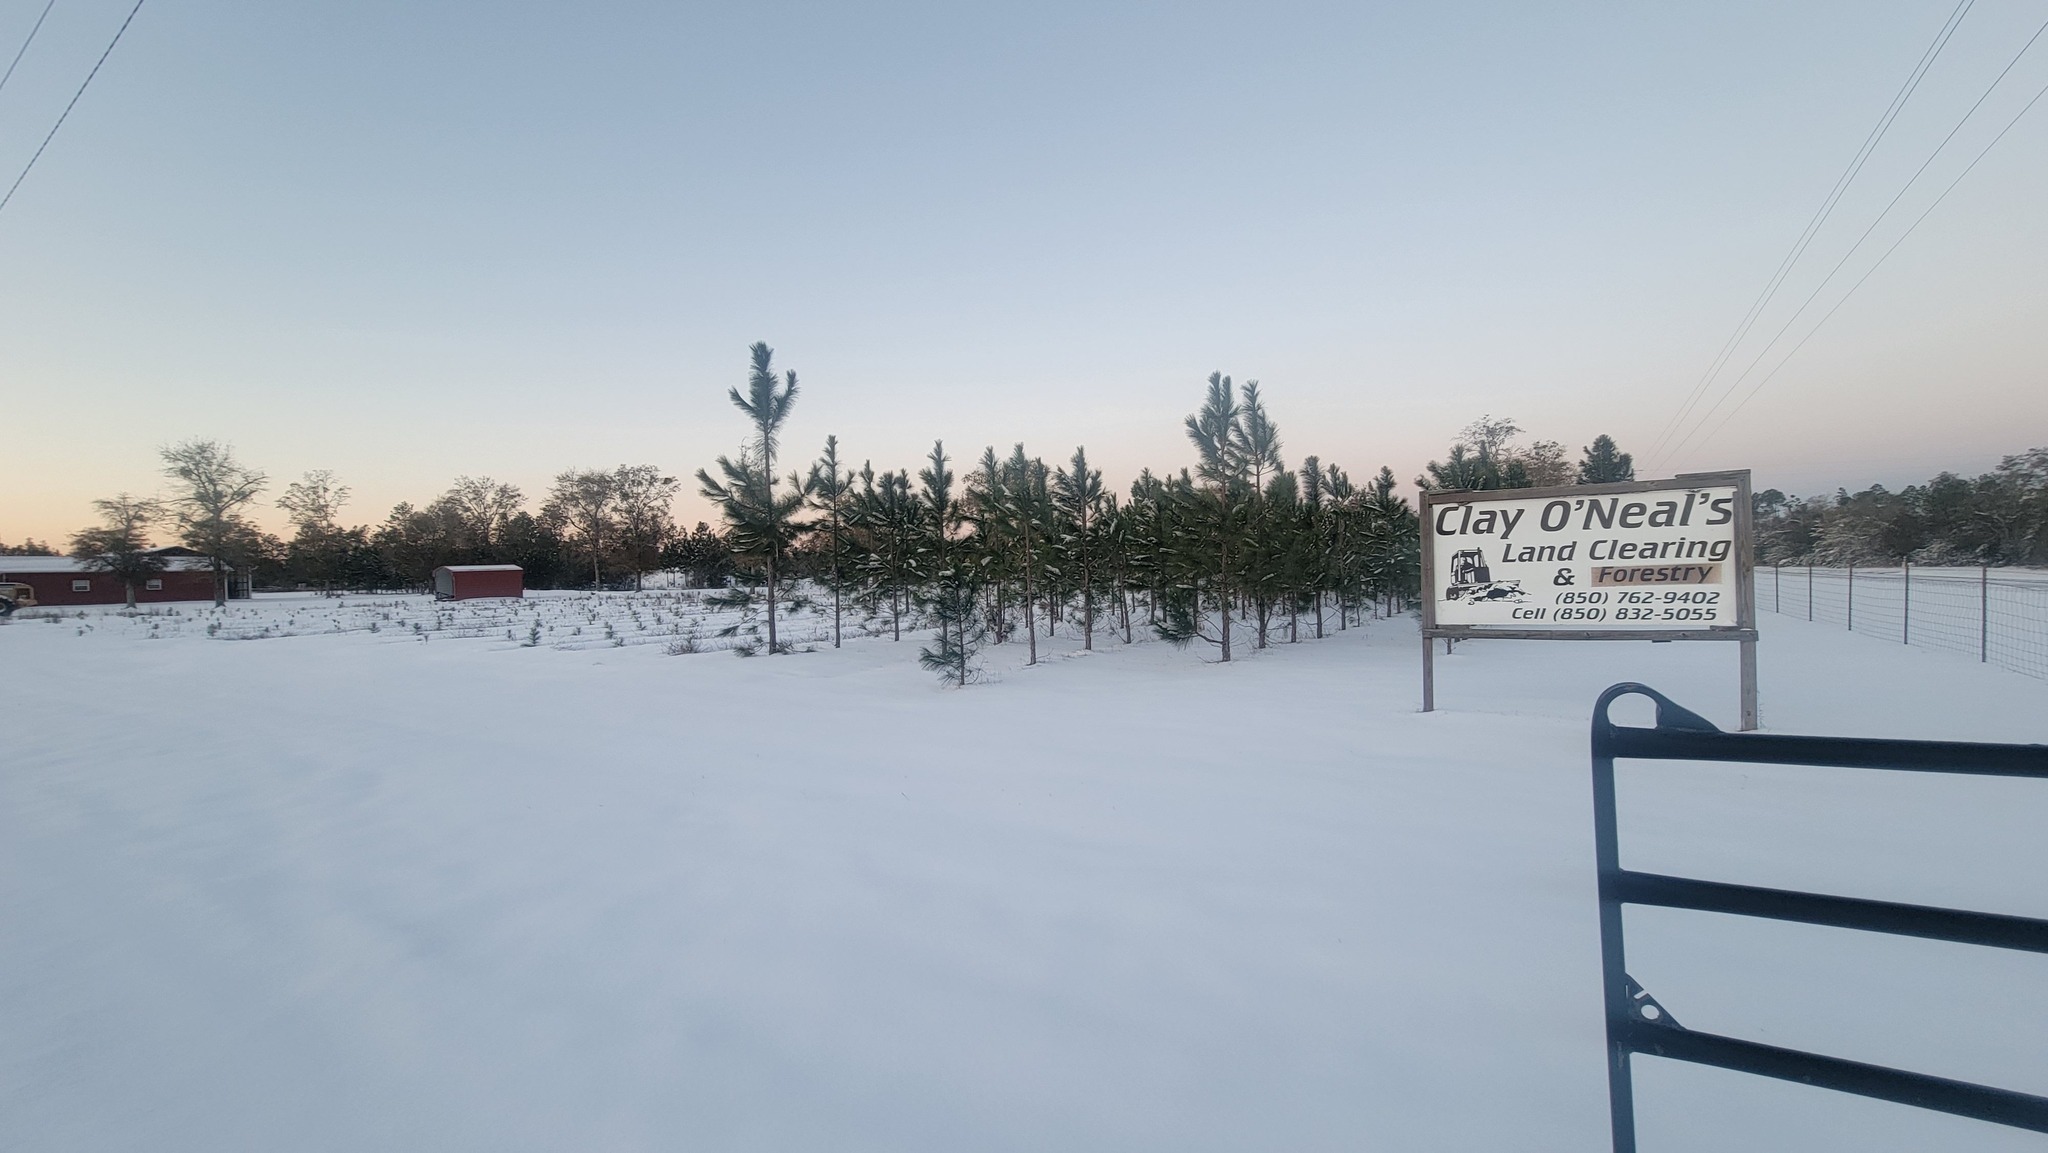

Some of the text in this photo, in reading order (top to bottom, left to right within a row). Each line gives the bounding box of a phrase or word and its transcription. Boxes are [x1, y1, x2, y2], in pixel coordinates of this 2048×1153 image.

[1435, 493, 1733, 539] Clay O'Neal's
[1502, 537, 1732, 563] Land Clearing
[1553, 565, 1713, 586] & Forestry
[1555, 591, 1720, 605] (850) 762-9402
[1512, 607, 1717, 622] Cell (850) 832-5055
